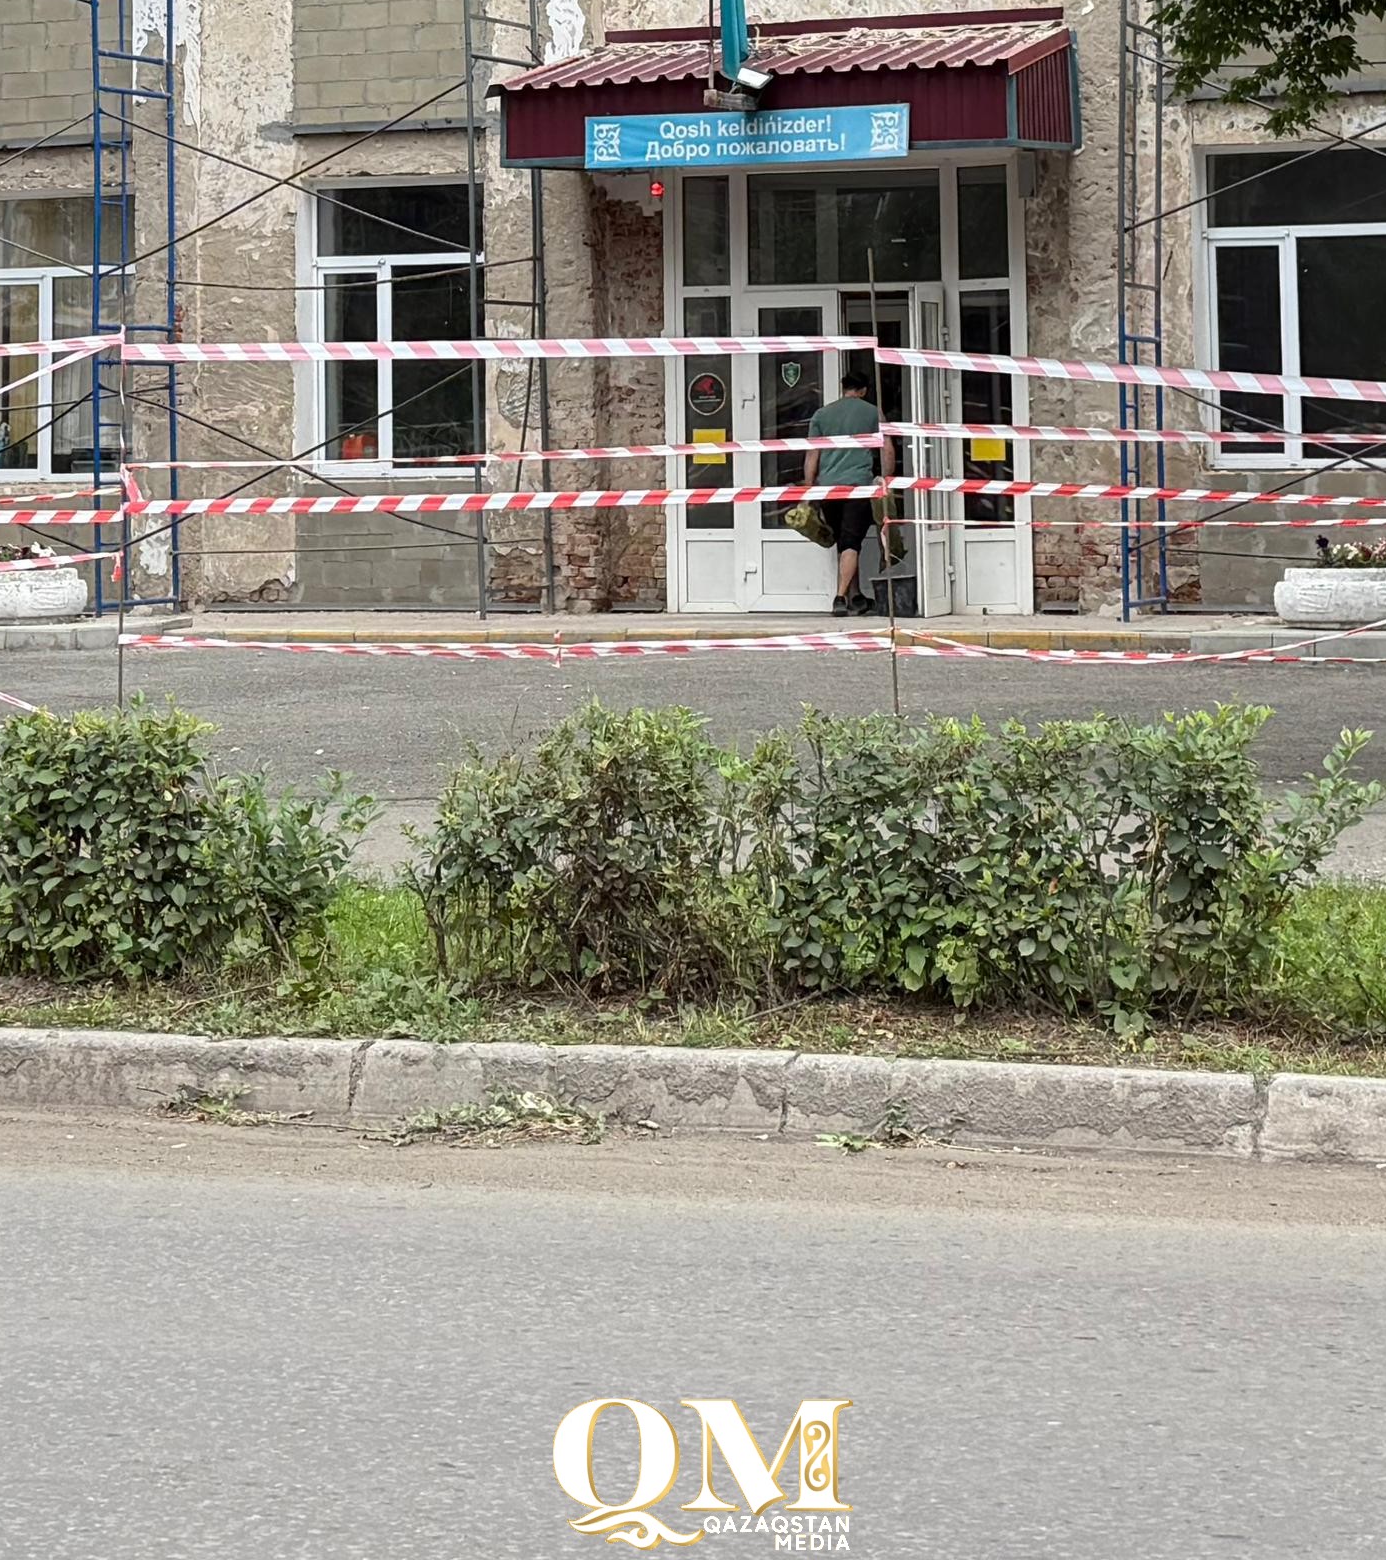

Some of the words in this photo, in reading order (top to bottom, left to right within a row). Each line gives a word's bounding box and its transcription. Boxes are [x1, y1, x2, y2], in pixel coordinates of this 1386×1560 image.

[659, 121, 711, 140] Qosh
[717, 115, 832, 137] keldińizder!
[645, 141, 710, 161] Добро
[716, 133, 846, 156] пожаловать!
